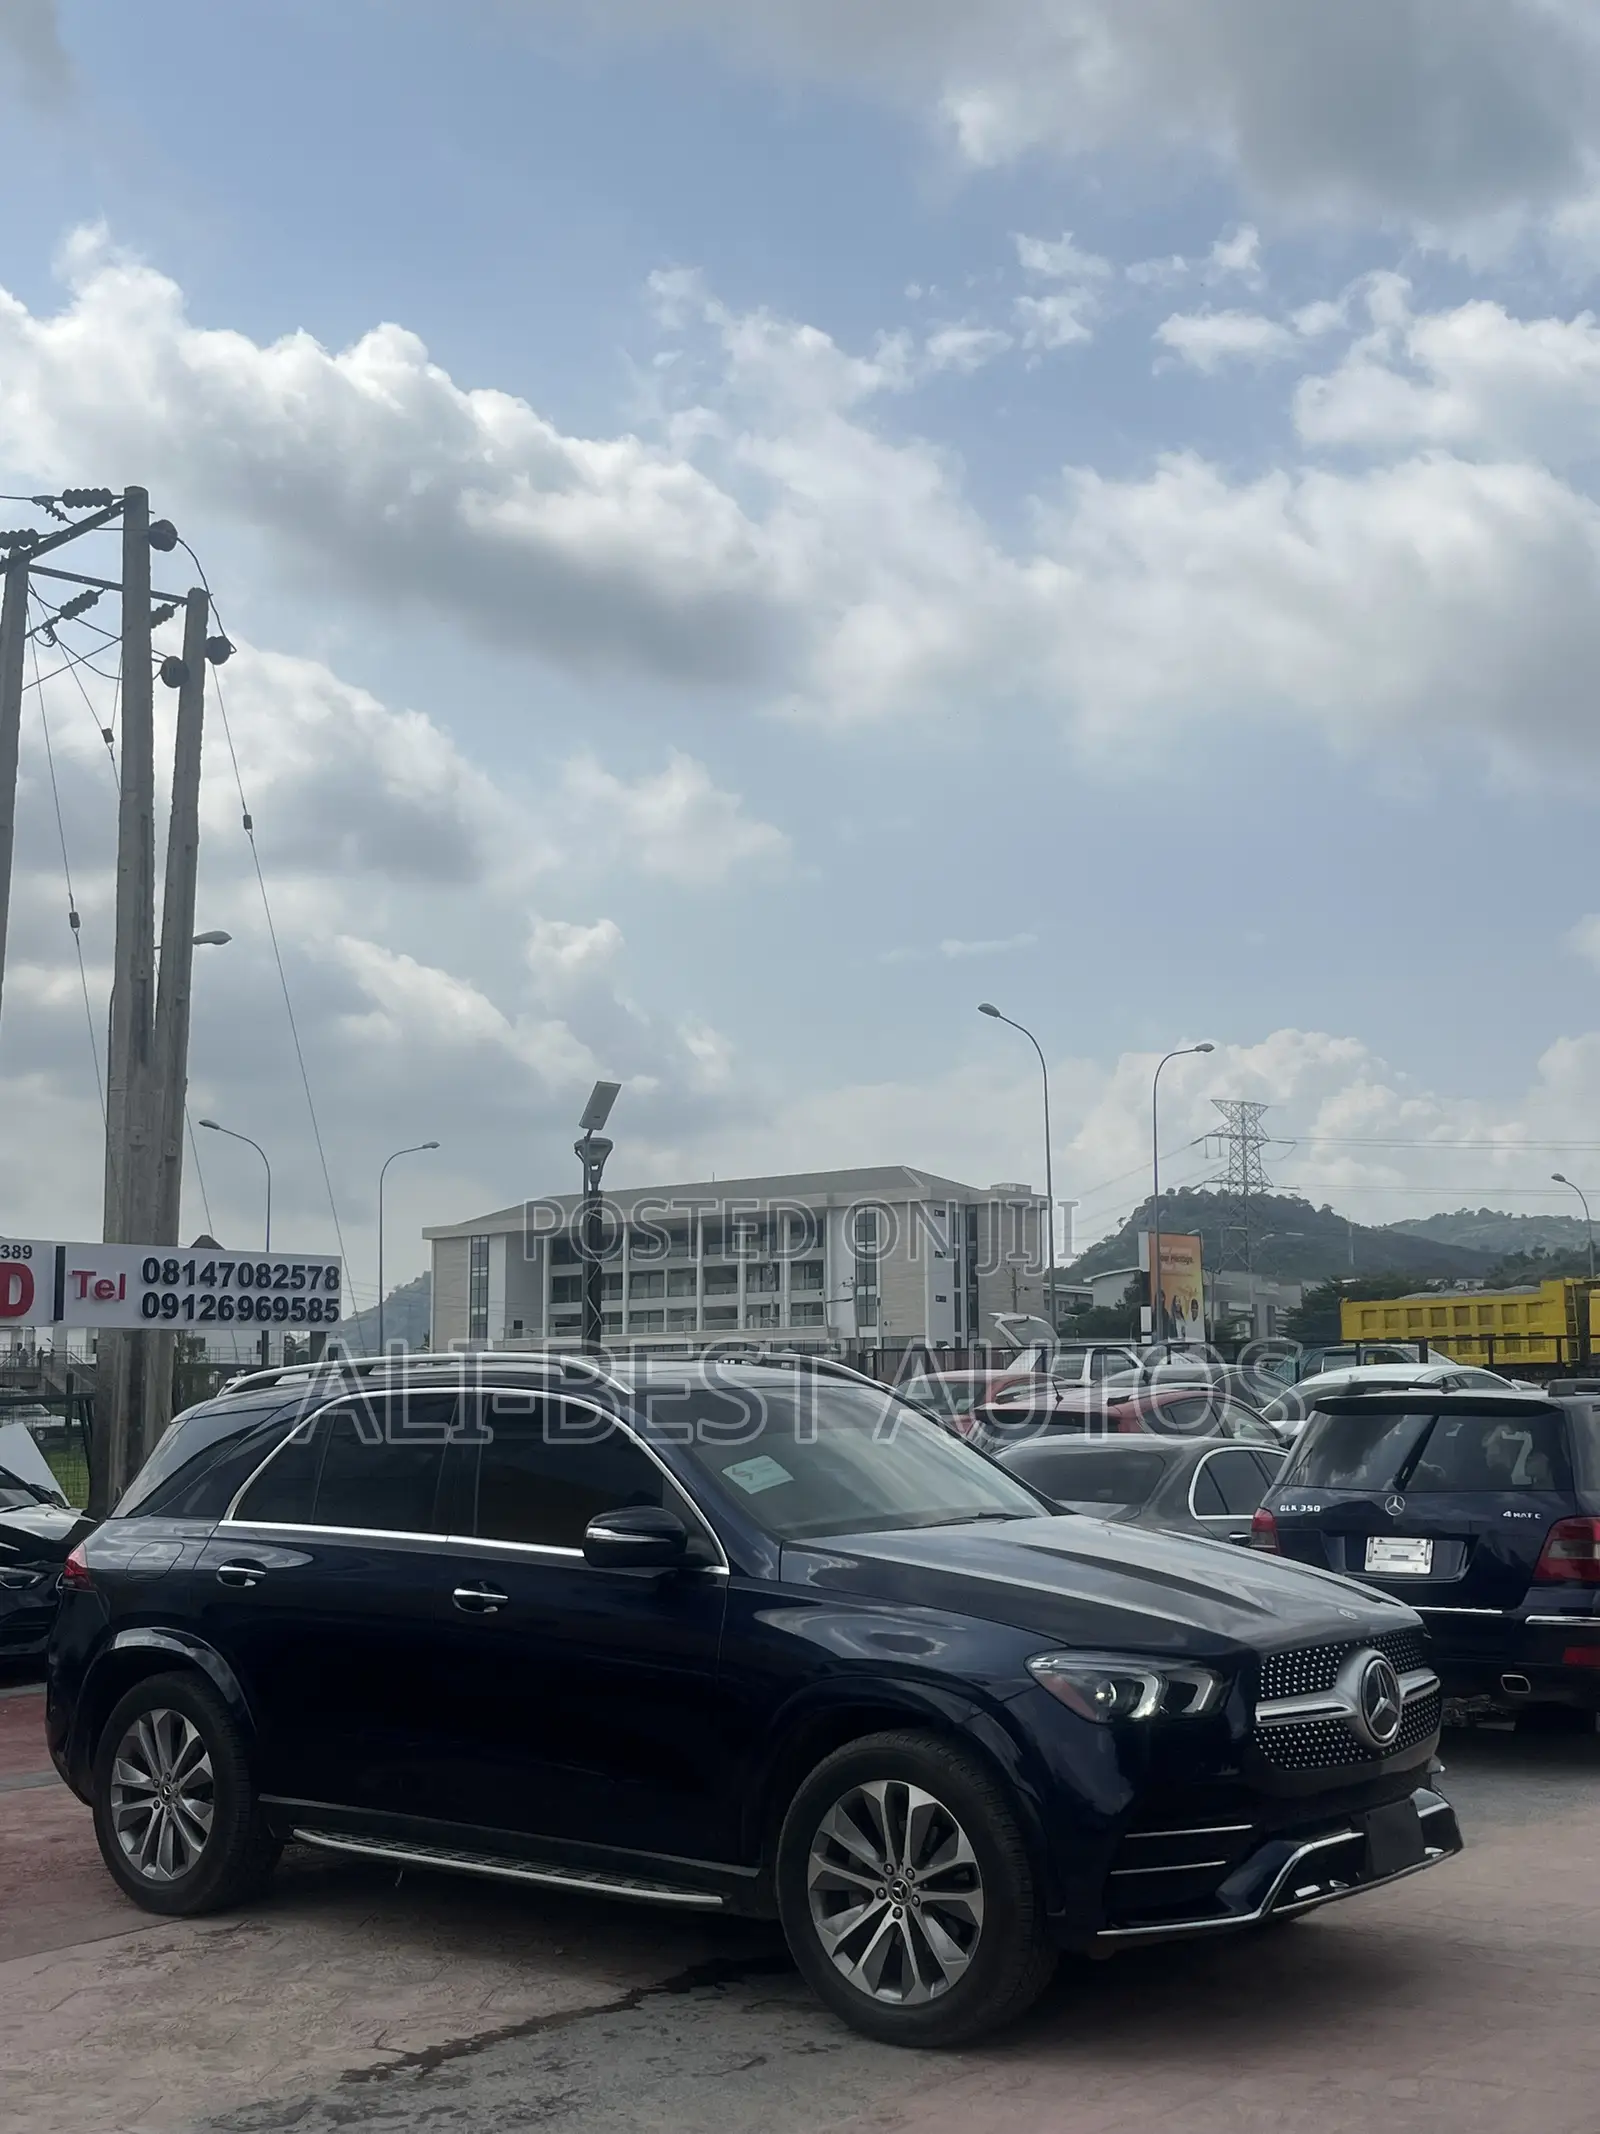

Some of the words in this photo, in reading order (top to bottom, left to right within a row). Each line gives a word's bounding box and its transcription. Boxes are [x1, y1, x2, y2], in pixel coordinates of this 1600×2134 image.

[69, 1270, 126, 1300] Tel
[142, 1257, 340, 1291] 08147082578
[141, 1292, 340, 1323] 09126969585
[1300, 1504, 1321, 1512] 350
[1502, 1510, 1542, 1520] 4MATC
